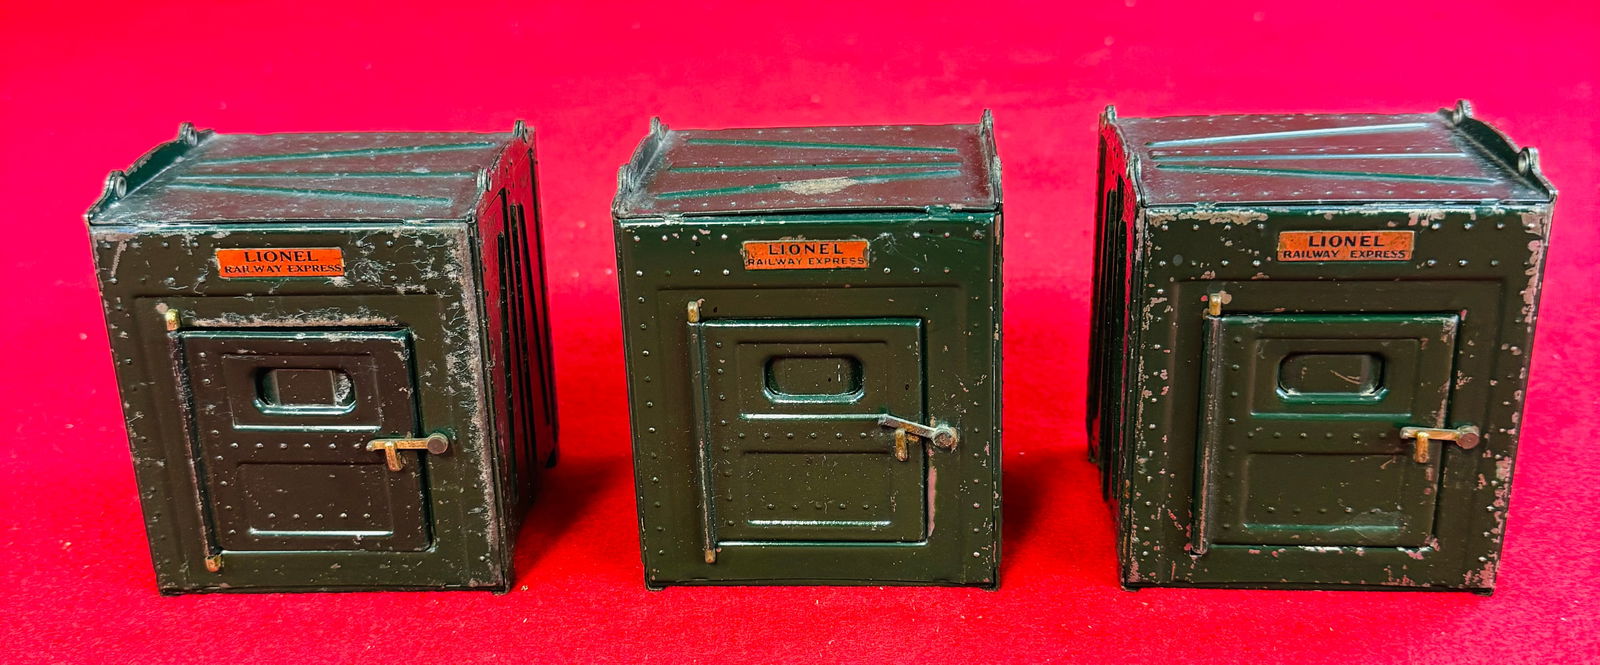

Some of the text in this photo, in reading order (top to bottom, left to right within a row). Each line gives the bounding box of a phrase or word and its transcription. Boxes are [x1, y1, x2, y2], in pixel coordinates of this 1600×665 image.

[1308, 236, 1385, 247] LIONEL
[769, 244, 843, 255] LIONEL
[1283, 250, 1407, 259] RAILWAY EXPRESS
[244, 251, 319, 262] LIONEL
[747, 257, 865, 266] RAILWAY EXPRESS
[224, 264, 342, 273] RAILWAY EXPRESS
